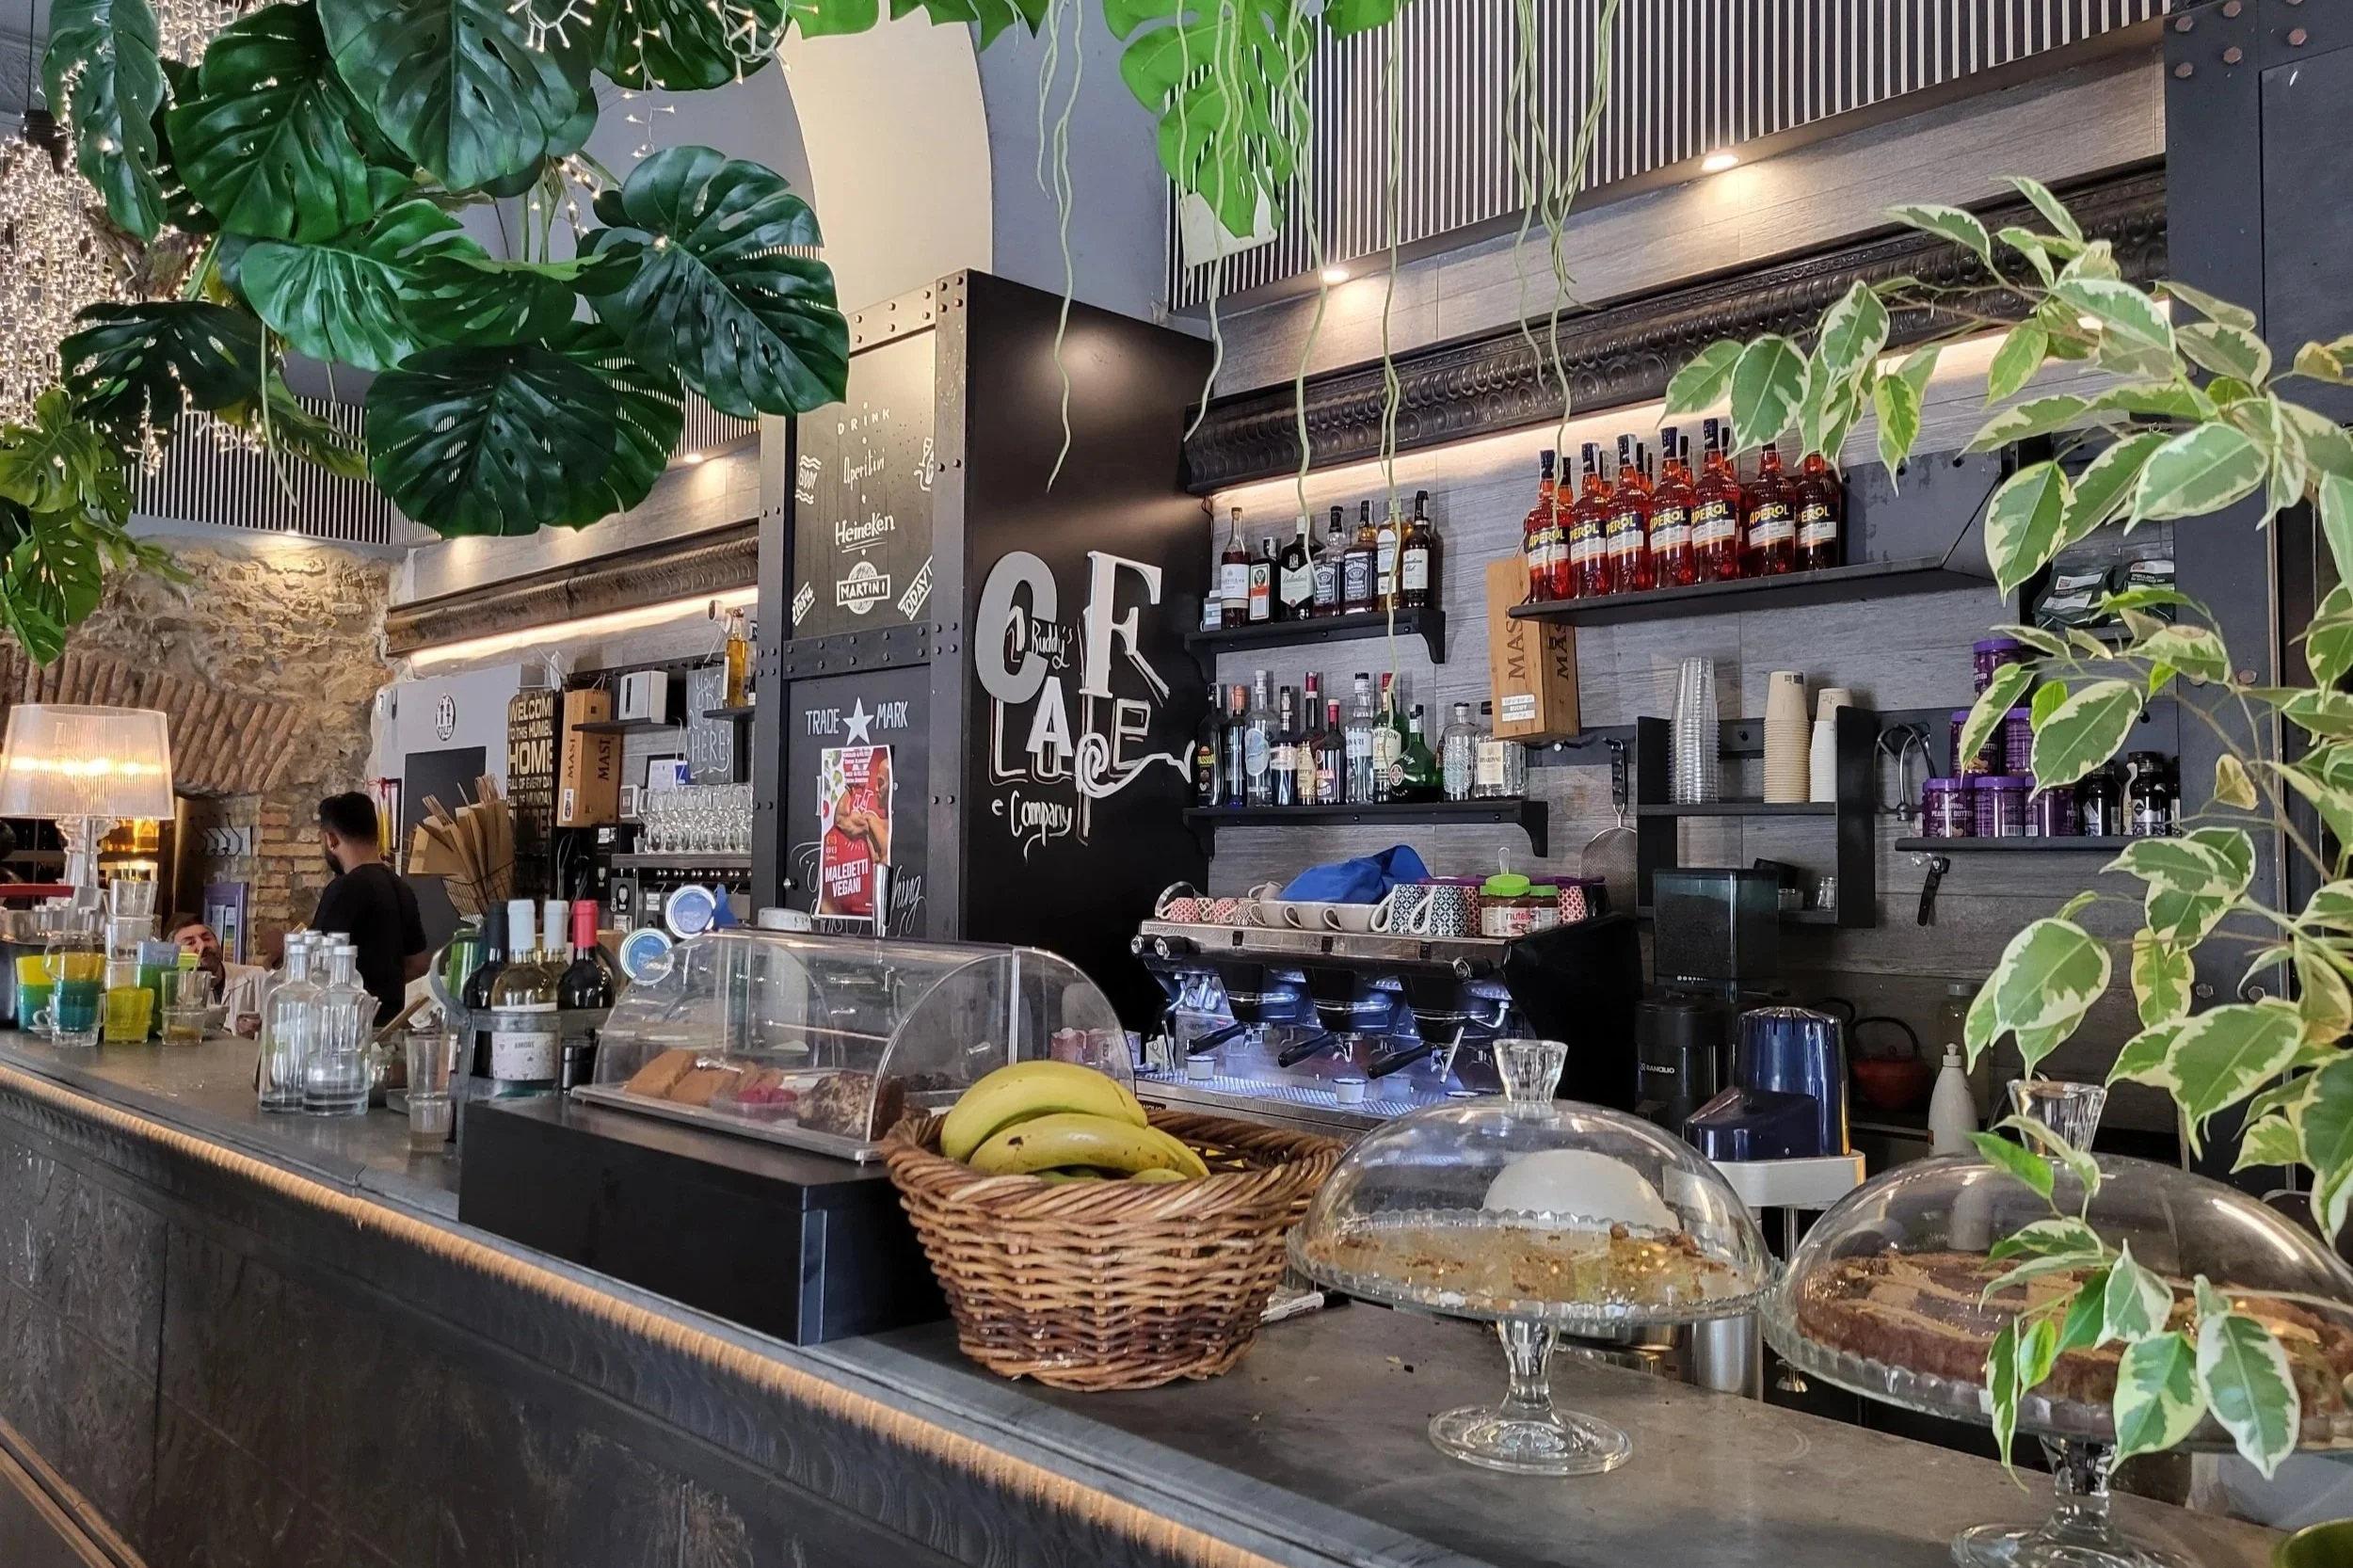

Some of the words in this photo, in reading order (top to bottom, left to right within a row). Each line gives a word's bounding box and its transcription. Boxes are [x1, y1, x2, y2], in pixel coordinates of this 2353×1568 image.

[837, 408, 891, 436] DRINK
[843, 447, 887, 491] Aperitivi
[1650, 508, 1686, 533] APEROL
[1691, 504, 1729, 525] APEROL
[1749, 504, 1789, 527] APEROL
[1528, 529, 1564, 550] APEROL
[840, 581, 887, 600] MARTINI
[1031, 618, 1074, 669] Buddy's
[1506, 610, 1526, 680] MAS
[508, 728, 516, 741] TO
[516, 726, 527, 740] THIS
[528, 720, 553, 738] HUMBL
[805, 708, 840, 736] TRADE
[875, 701, 909, 729] MARK
[691, 729, 727, 763] HERE
[598, 737, 612, 781] MASI
[519, 776, 526, 790] OF
[1010, 790, 1073, 862] Company
[825, 858, 869, 883] MALEDETTI
[832, 877, 861, 898] VEGANI
